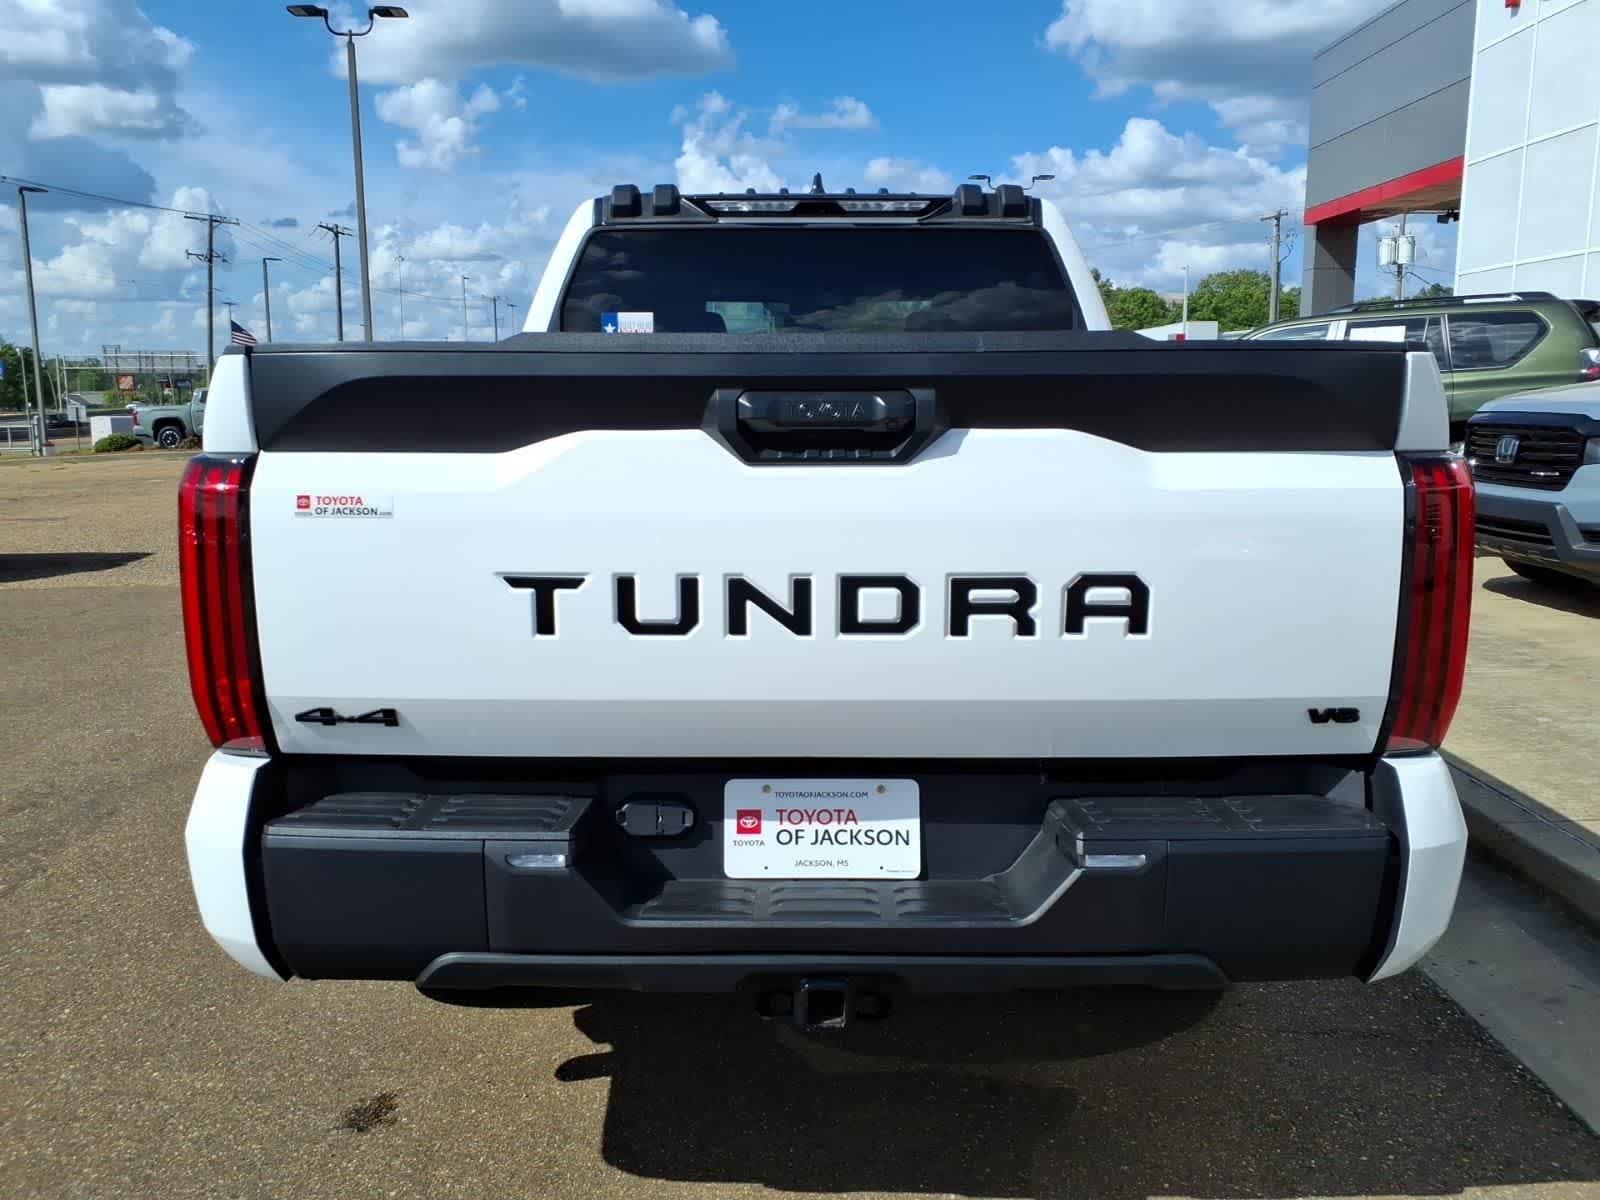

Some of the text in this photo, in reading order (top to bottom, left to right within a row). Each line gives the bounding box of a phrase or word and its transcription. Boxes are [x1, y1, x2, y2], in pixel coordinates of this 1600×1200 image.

[315, 496, 364, 506] TOYOTA
[314, 507, 329, 516] OF
[495, 571, 1153, 639] TUNDRA
[774, 791, 869, 799] TOYOTAOFJACKSON.COM
[775, 808, 859, 826] TOYOTA
[775, 828, 911, 847] OF JACKSON
[732, 839, 766, 847] TOYOTA
[794, 859, 850, 869] JACKSON, MS
